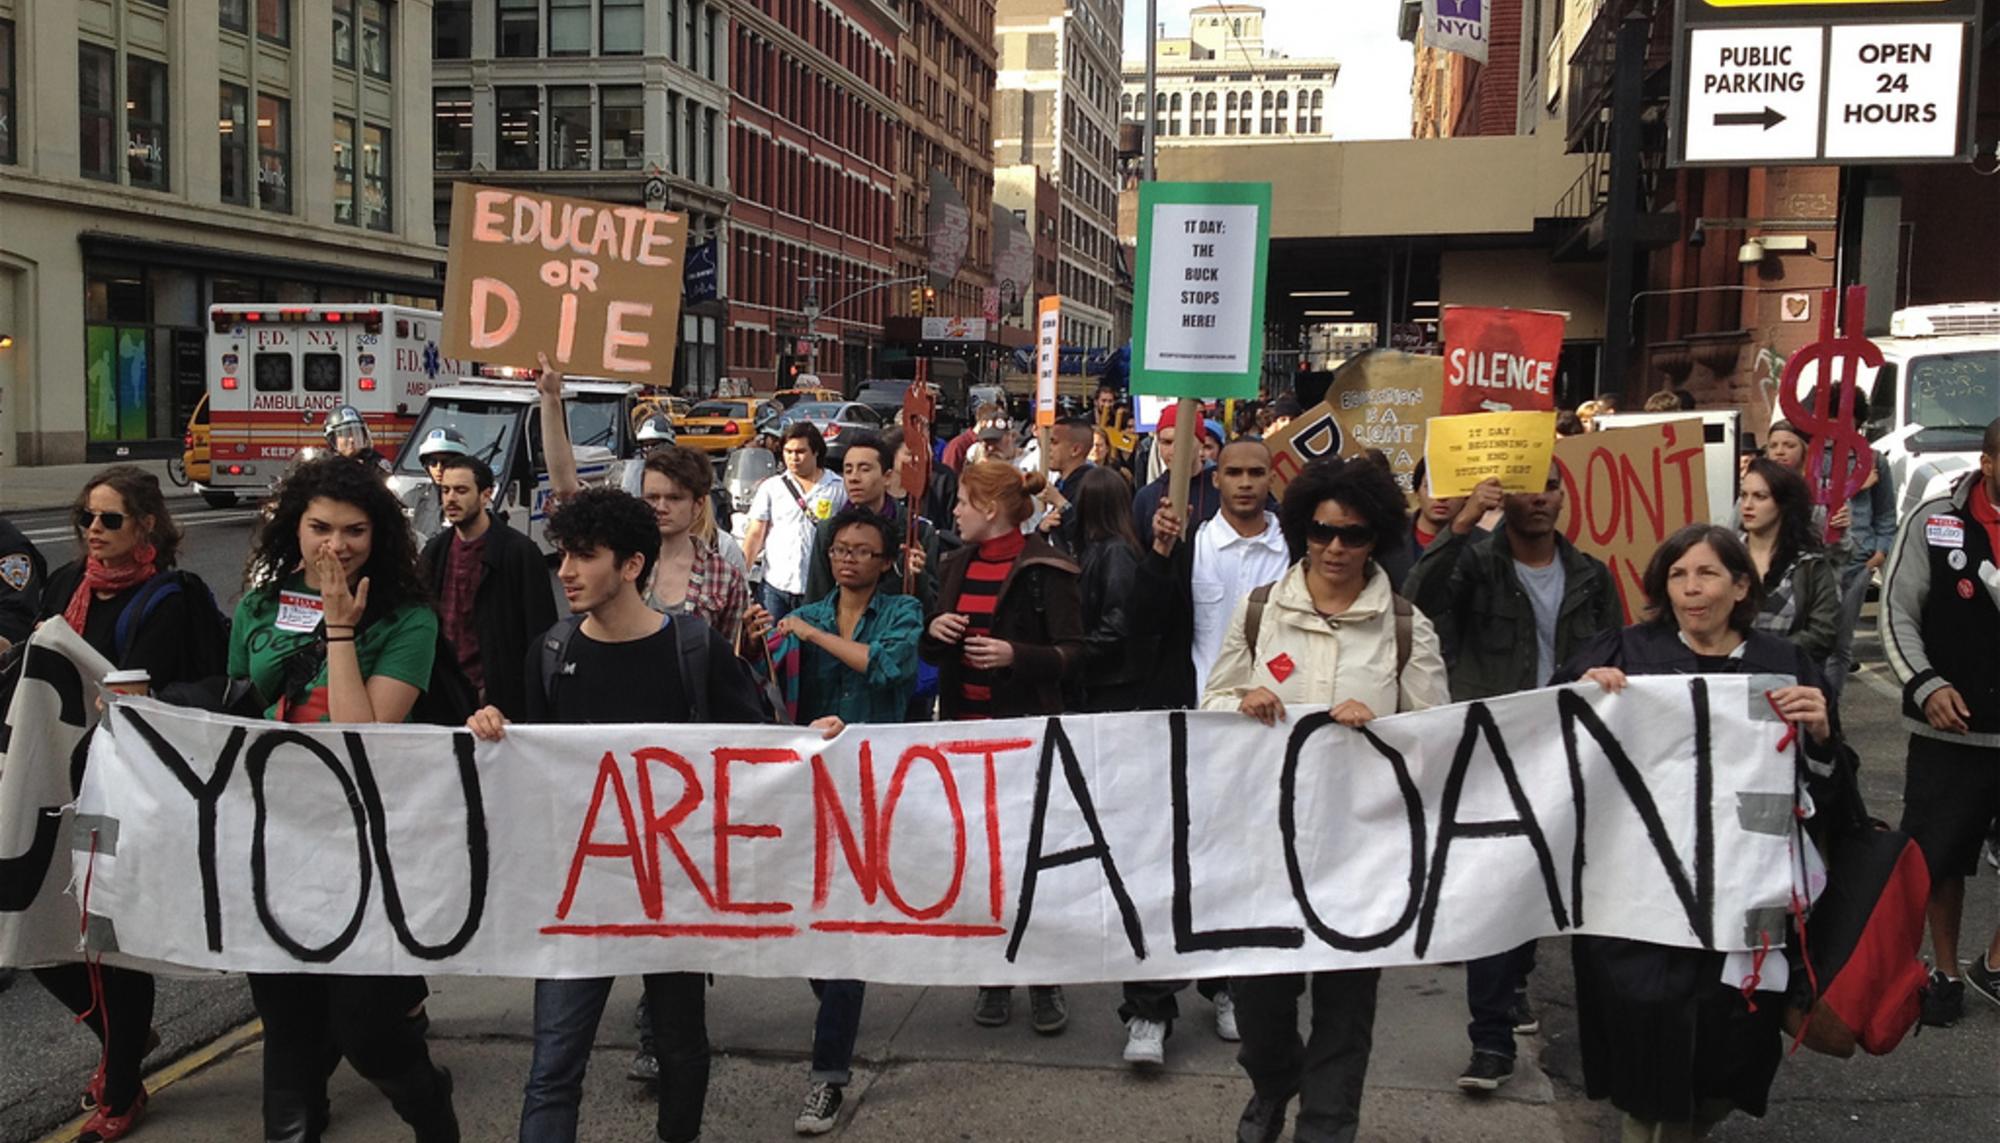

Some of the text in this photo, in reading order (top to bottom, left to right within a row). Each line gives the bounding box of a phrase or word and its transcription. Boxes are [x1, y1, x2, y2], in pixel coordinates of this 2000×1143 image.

[1437, 18, 1482, 40] NYU
[1720, 46, 1792, 67] PUBLIC
[1858, 43, 1932, 64] OPEN
[1704, 72, 1805, 94] PARKING
[1876, 74, 1909, 93] 24
[1843, 103, 1937, 123] HOURS
[473, 190, 680, 266] EDUCATE
[1199, 220, 1226, 234] DAY:
[1192, 244, 1214, 257] THE
[540, 259, 599, 292] OR
[1185, 268, 1219, 281] BUCK
[1181, 291, 1220, 304] STOPS
[470, 277, 653, 372] DIE
[1182, 315, 1216, 327] HERE!
[258, 331, 338, 345] F.D. N.Y.
[1449, 348, 1553, 394] SILENCE
[254, 395, 342, 409] AMBULANCE
[1380, 408, 1397, 424] A
[261, 446, 295, 457] KEEP
[120, 705, 489, 962] YOU
[555, 746, 801, 922] ARE
[812, 740, 1033, 922] NOT
[1006, 716, 1147, 963] A
[1170, 677, 1714, 957] LOAN
